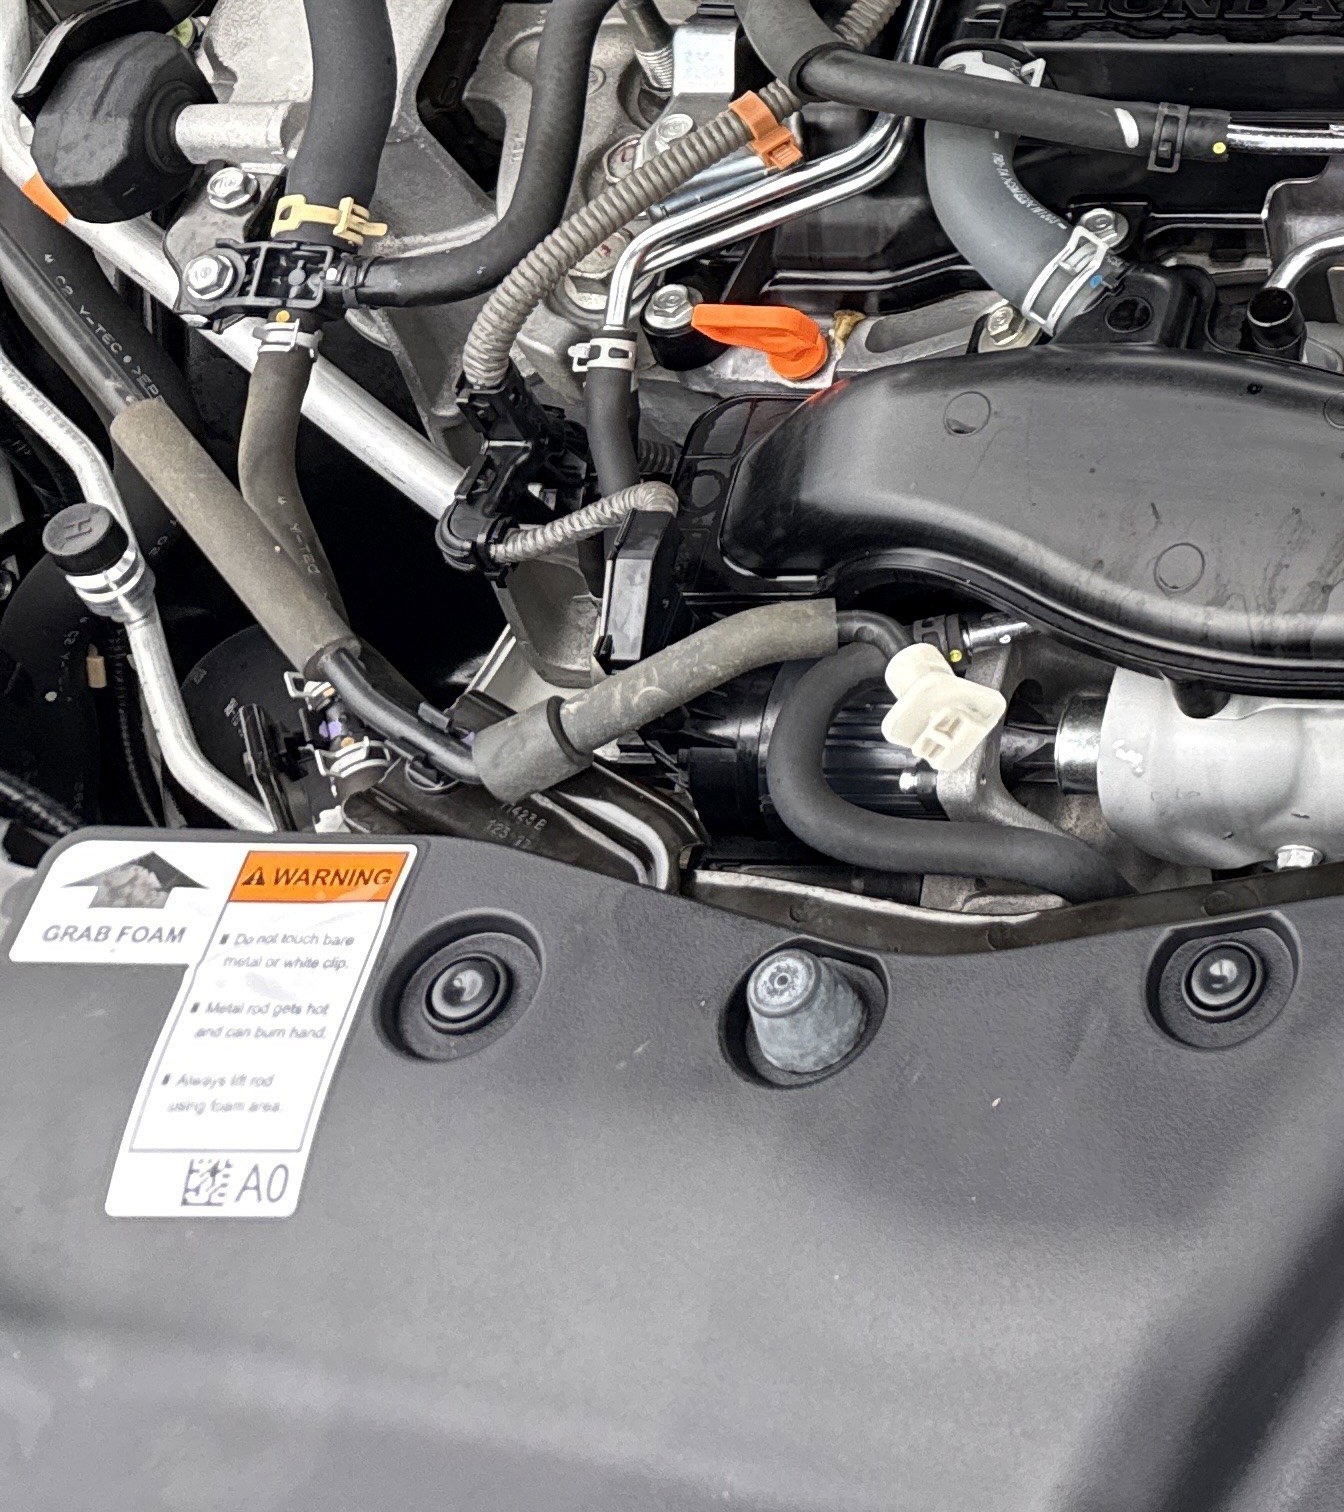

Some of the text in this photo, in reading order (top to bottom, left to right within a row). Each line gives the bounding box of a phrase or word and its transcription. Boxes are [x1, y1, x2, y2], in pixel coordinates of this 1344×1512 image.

[79, 305, 123, 354] Y-TEC
[273, 868, 393, 887] WARNING
[42, 924, 188, 943] GRAB FOAM
[234, 933, 355, 946] Do not touch bare
[223, 956, 263, 968] metal
[265, 958, 281, 968] or
[284, 956, 319, 968] white
[205, 1002, 330, 1018] Metal rod gets hot
[194, 1026, 224, 1038] and
[225, 1027, 251, 1038] can
[254, 1026, 286, 1038] burn
